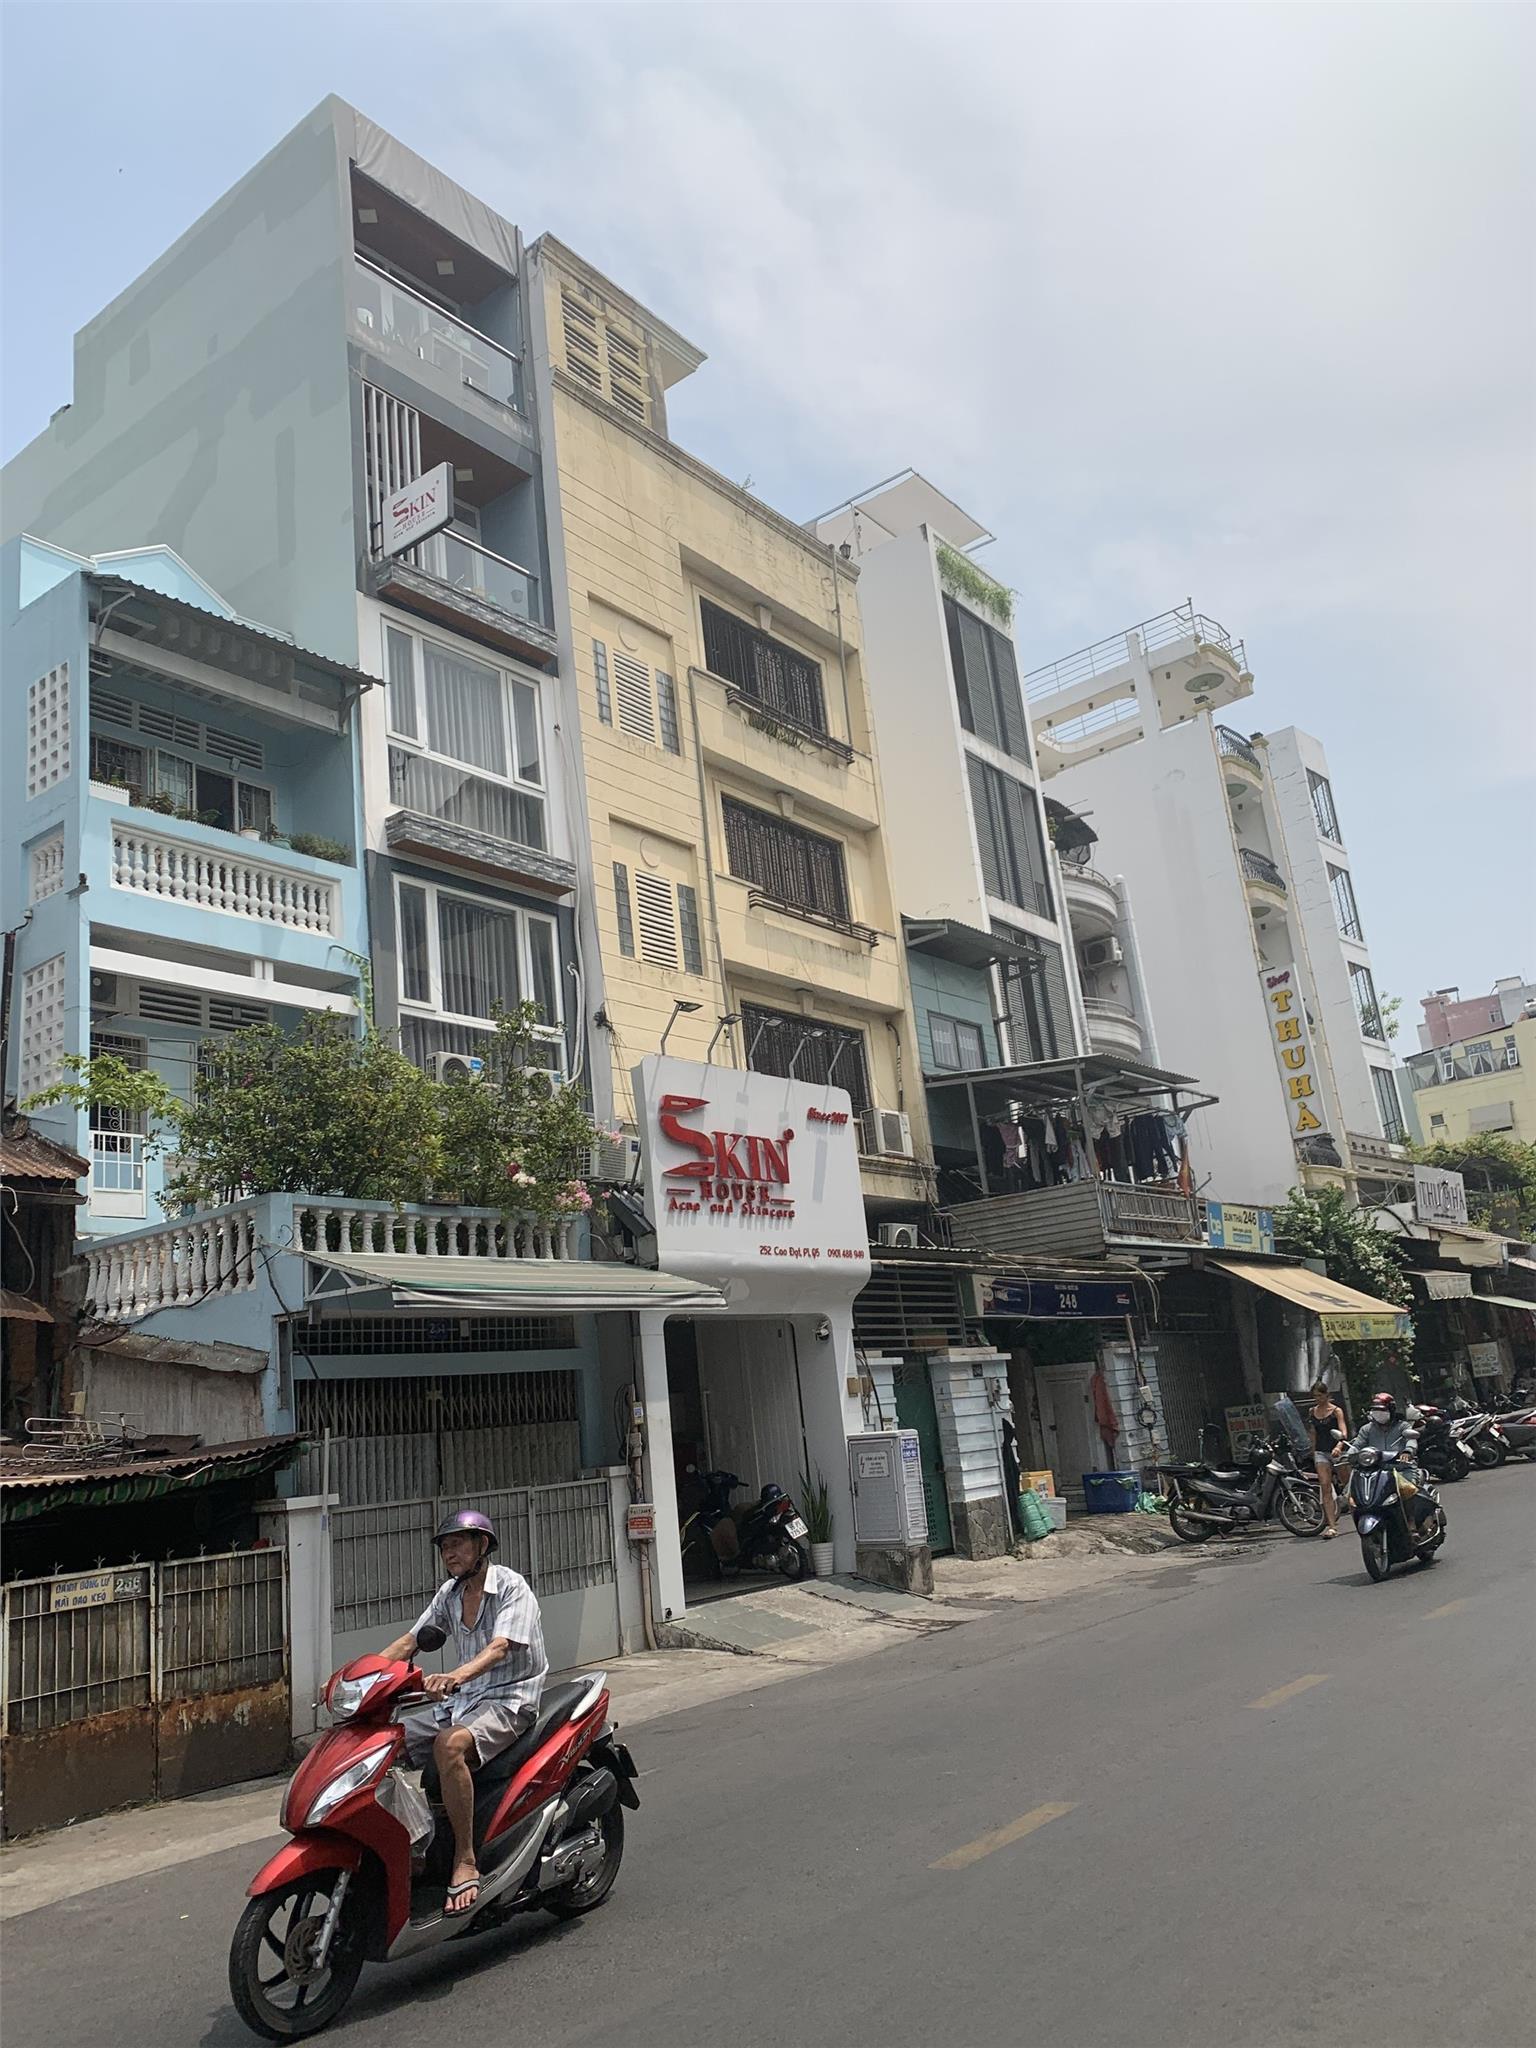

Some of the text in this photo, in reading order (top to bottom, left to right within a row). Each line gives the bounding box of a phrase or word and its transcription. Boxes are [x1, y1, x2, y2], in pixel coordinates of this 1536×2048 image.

[392, 488, 436, 528] SKIN
[659, 1094, 791, 1184] SKIN
[700, 1181, 770, 1201] HOUSE
[669, 1197, 795, 1218] Acne and Skincare
[759, 1245, 772, 1255] 252
[1059, 1293, 1078, 1309] 248
